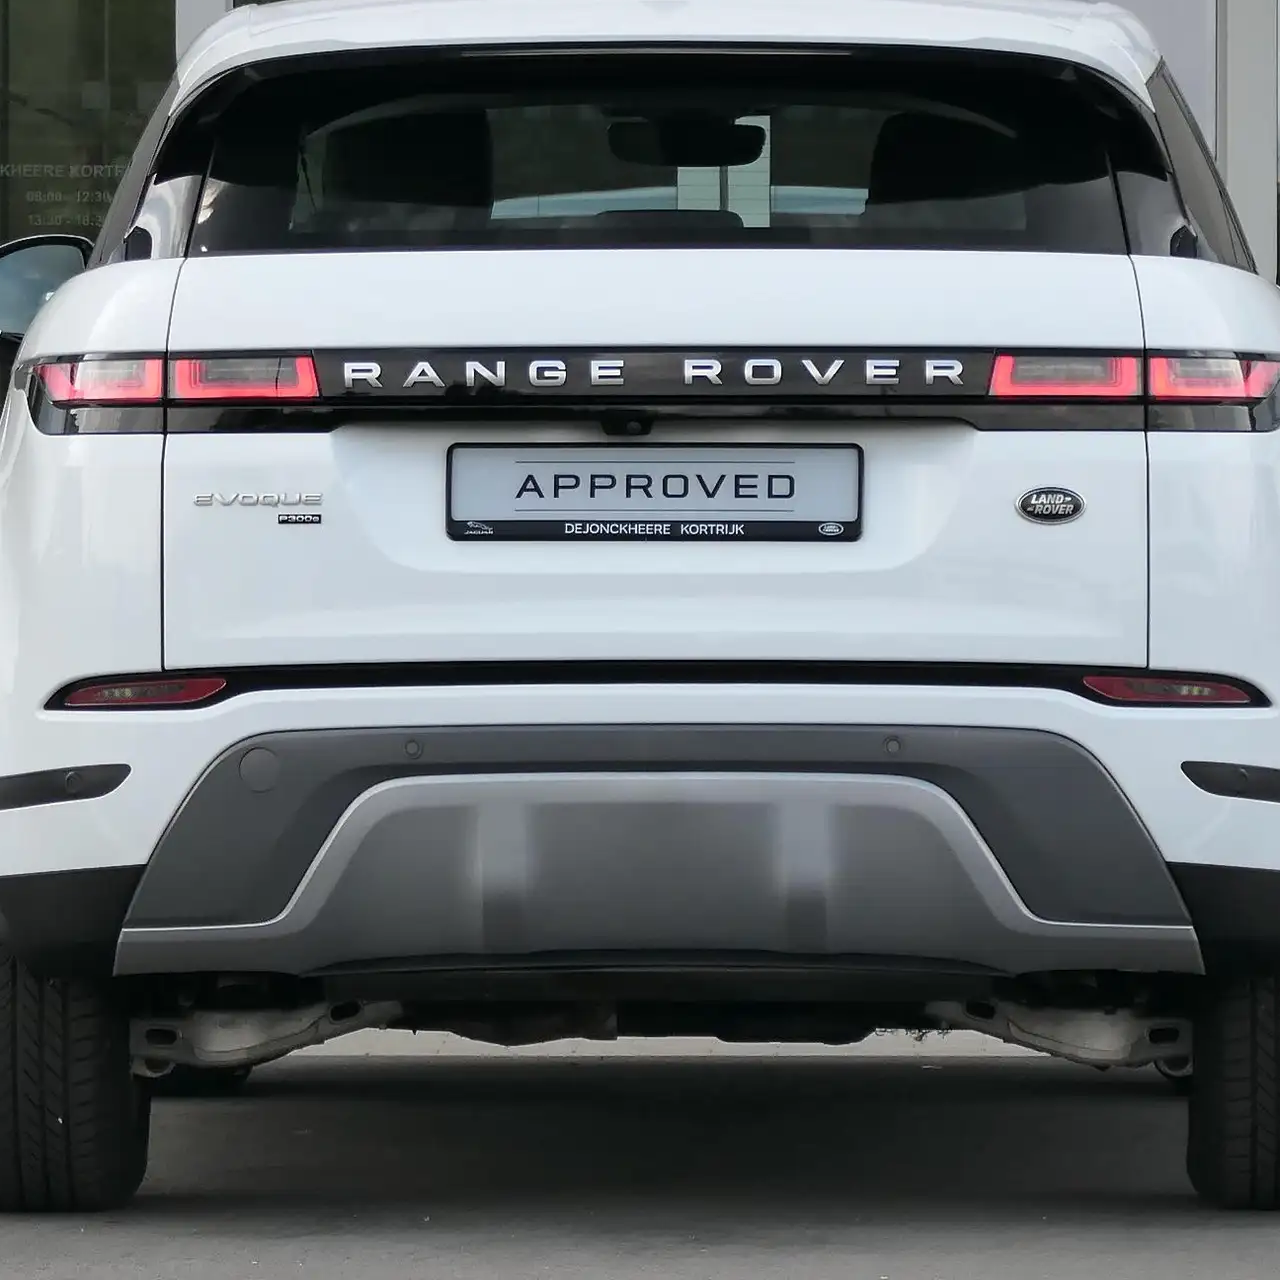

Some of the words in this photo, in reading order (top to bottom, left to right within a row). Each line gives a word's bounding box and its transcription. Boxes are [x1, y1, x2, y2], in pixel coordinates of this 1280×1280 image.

[69, 164, 126, 178] KORTR
[344, 360, 624, 387] RANGE
[684, 359, 963, 384] ROVER
[516, 474, 794, 498] APPROVED
[194, 492, 323, 507] EVOQUE
[1031, 494, 1064, 504] LAND
[1034, 504, 1074, 514] ROVER
[565, 523, 670, 534] DEJONCKHEERE
[681, 524, 744, 534] KORTRIJK
